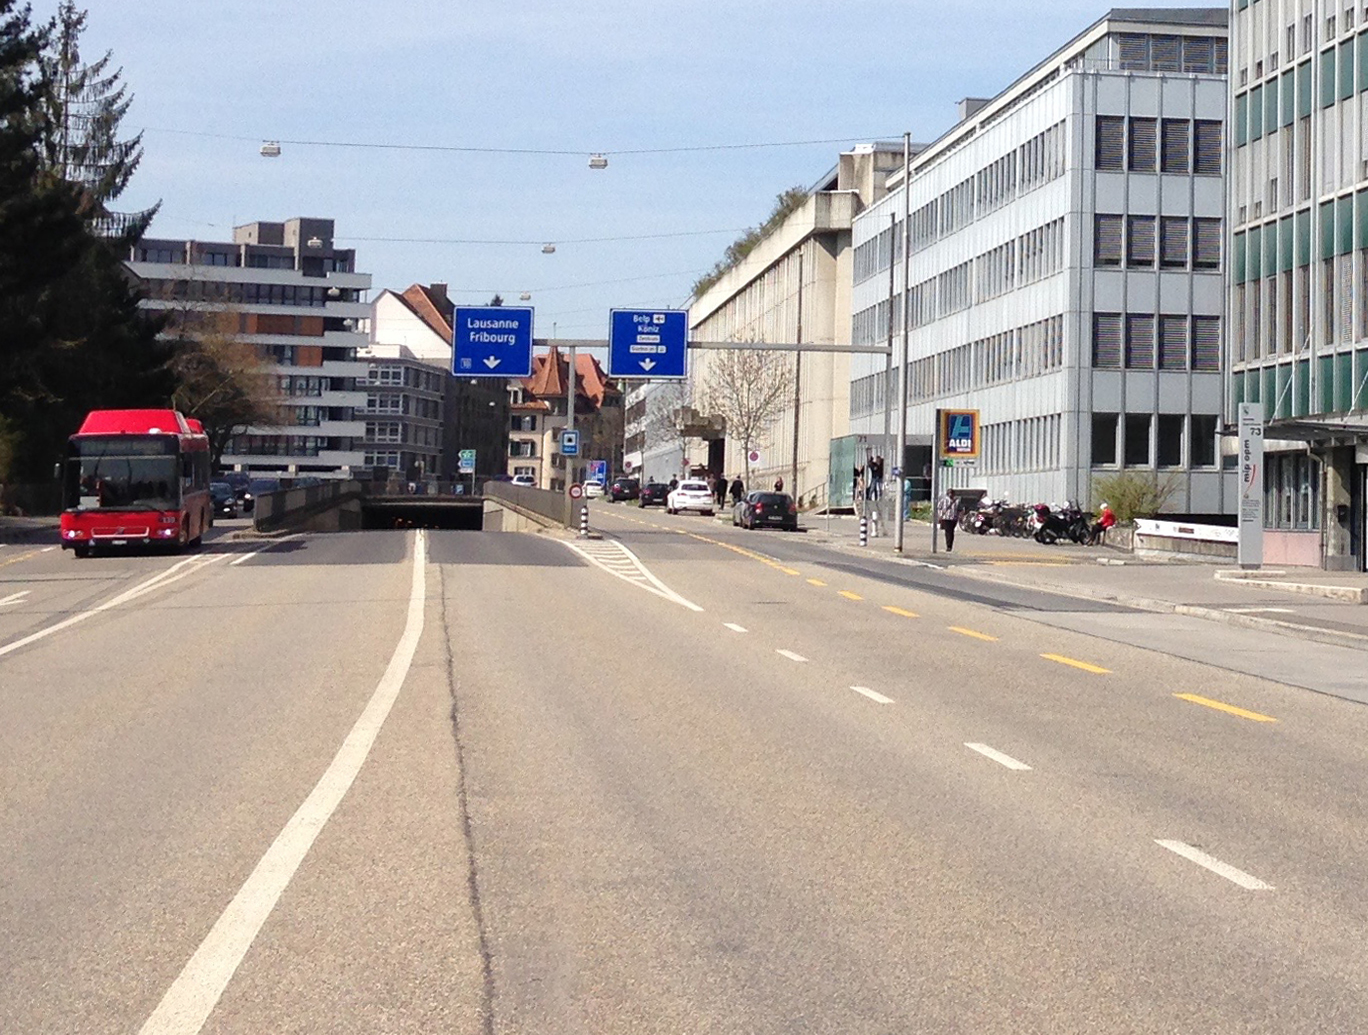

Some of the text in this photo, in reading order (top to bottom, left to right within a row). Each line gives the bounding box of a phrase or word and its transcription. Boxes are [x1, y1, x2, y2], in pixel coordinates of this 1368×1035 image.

[467, 317, 519, 329] Lausanne
[633, 314, 650, 324] Belp
[469, 331, 516, 346] Fribourg
[1250, 427, 1262, 436] 73
[949, 439, 972, 448] ALDI
